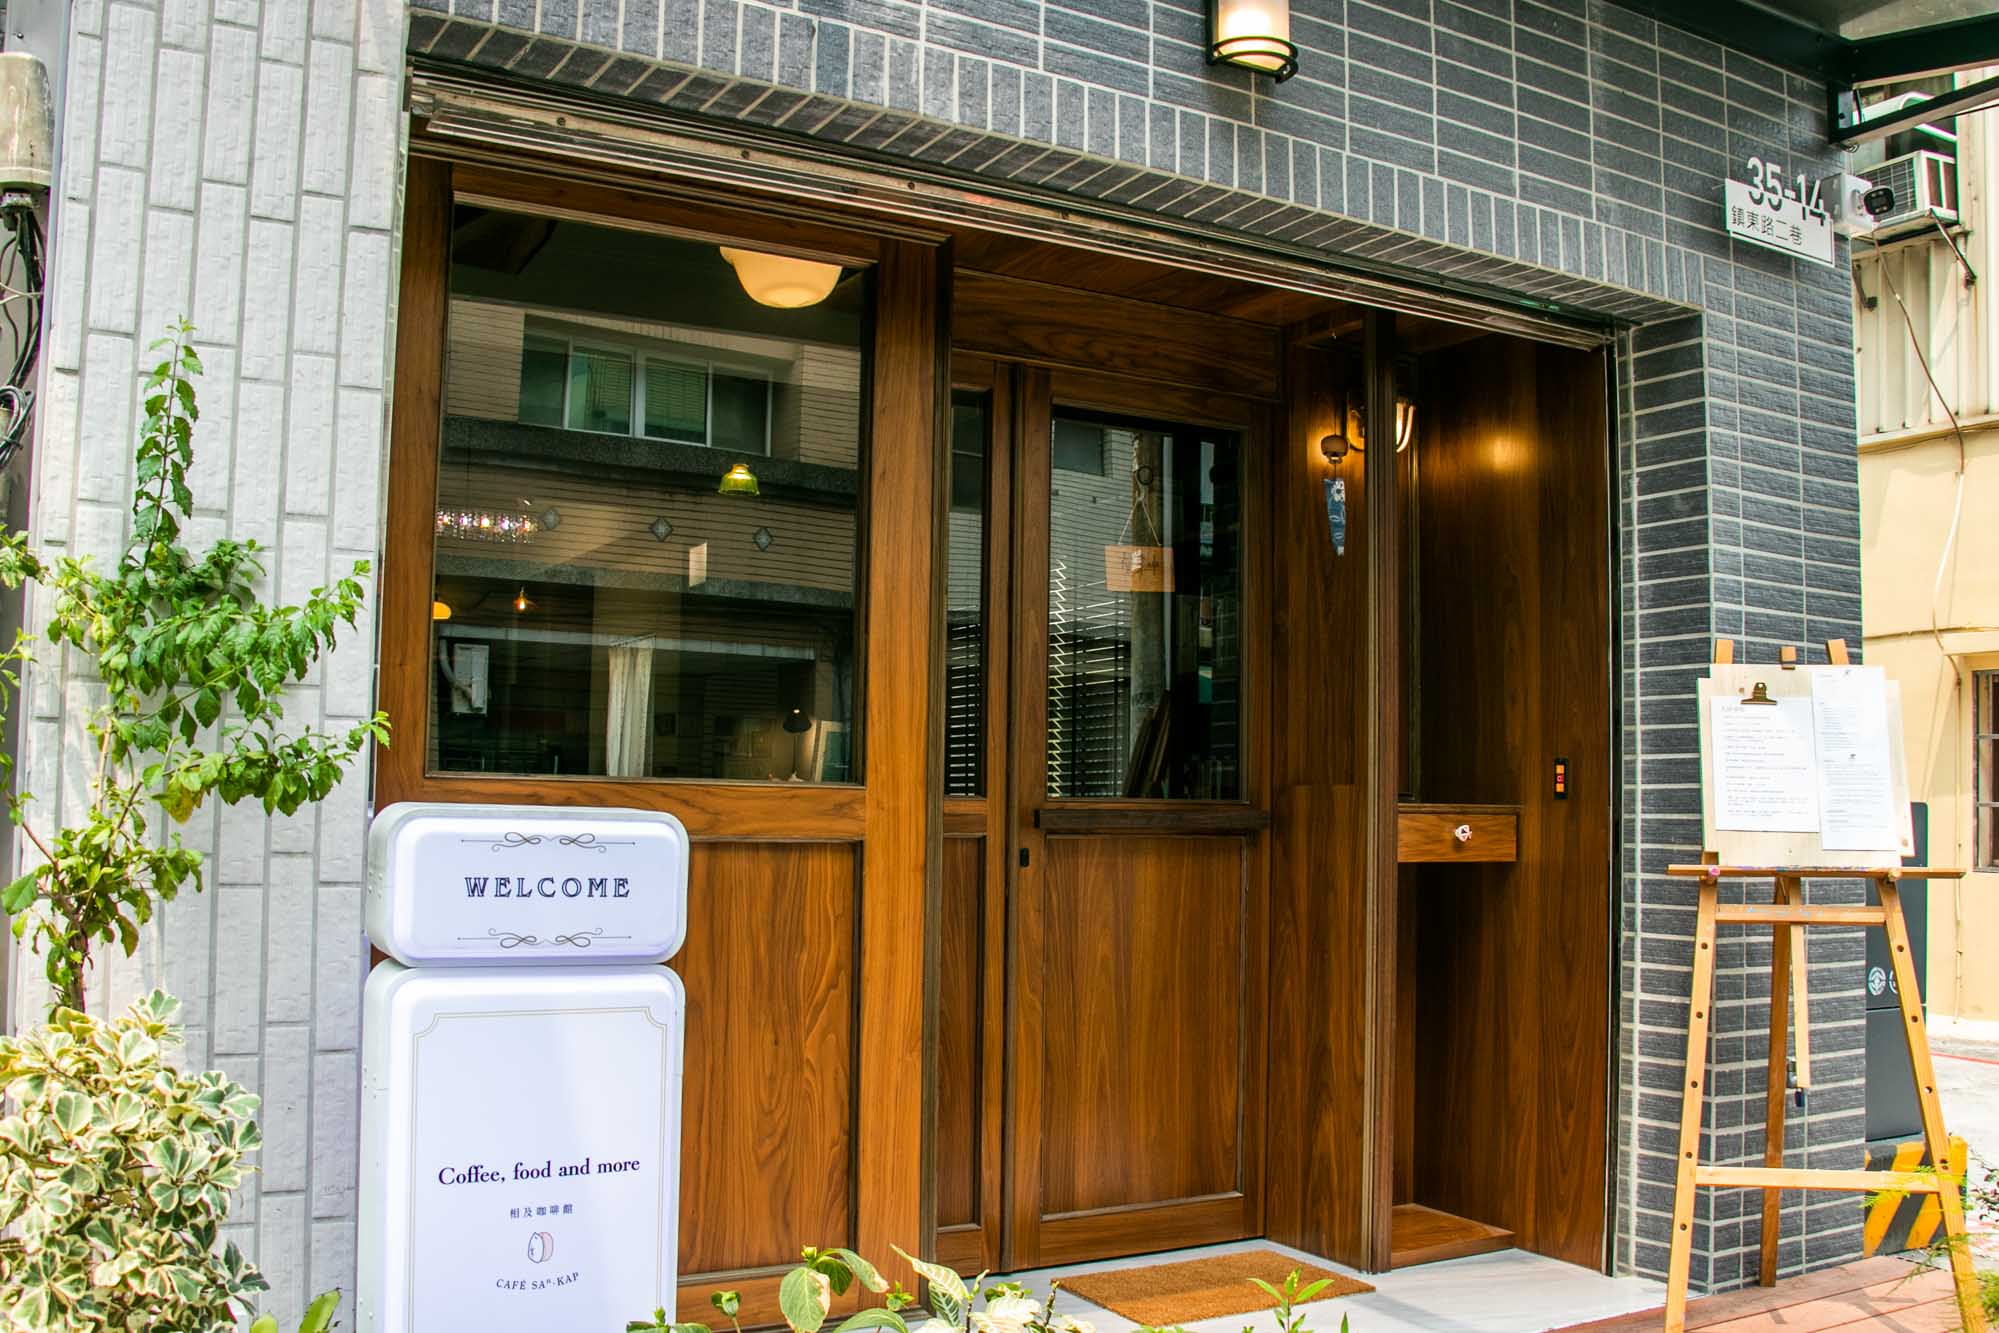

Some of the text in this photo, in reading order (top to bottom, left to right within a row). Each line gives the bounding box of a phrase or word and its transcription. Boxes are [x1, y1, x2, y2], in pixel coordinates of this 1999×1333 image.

[1746, 156, 1827, 227] 35-14
[1731, 205, 1802, 246] 鎮東路二巷
[464, 876, 631, 899] WELCOME
[438, 1157, 640, 1185] Coffee, food and more
